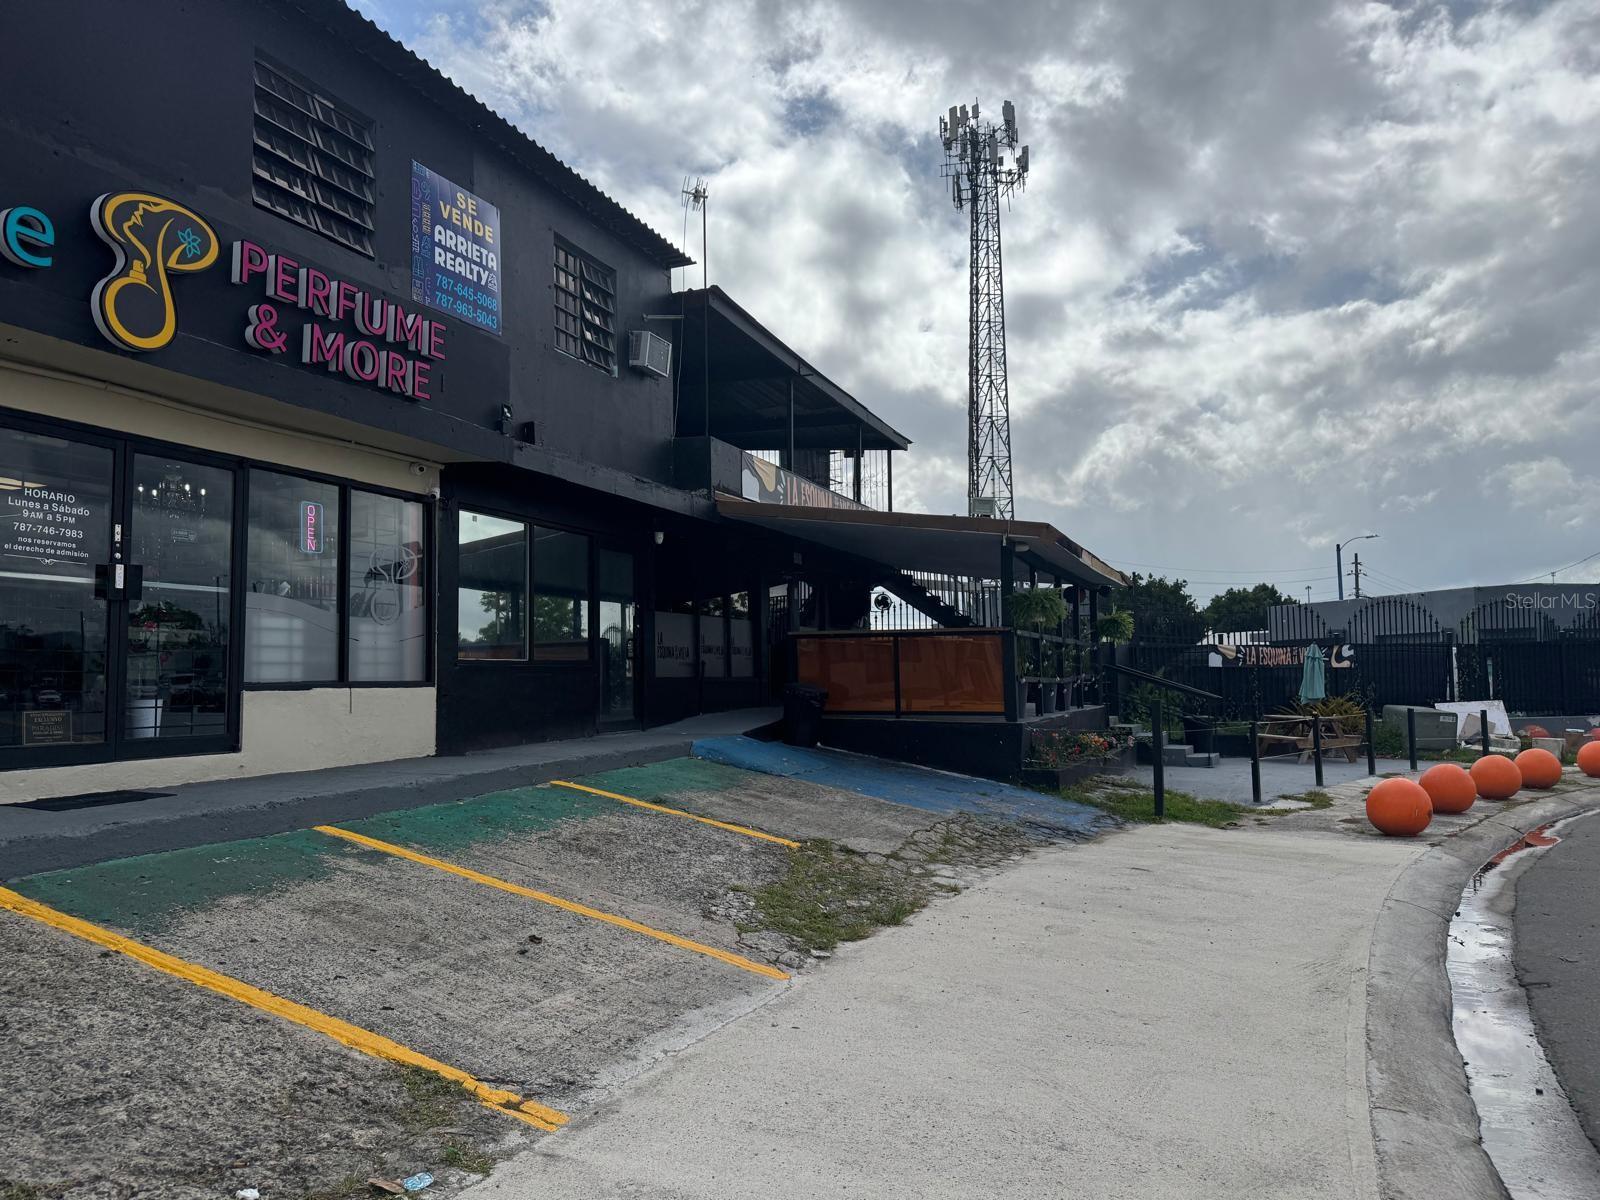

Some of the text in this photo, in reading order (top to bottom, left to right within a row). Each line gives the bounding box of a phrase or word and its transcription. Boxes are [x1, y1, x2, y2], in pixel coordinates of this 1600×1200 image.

[456, 192, 478, 216] SE
[439, 200, 494, 244] VENDE
[434, 224, 498, 271] ARRIETA
[434, 246, 489, 286] REALTY
[232, 240, 447, 361] PERFUME
[435, 273, 497, 311] 787-645-5068
[435, 291, 497, 329] 787-963-5043
[247, 304, 431, 400] & MORE
[8, 496, 40, 509] Lunes
[51, 503, 90, 516] Sábado
[24, 488, 75, 504] HORARIO
[13, 521, 83, 539] 787-746-7983
[46, 513, 53, 521] a
[307, 505, 316, 551] OPEN
[13, 543, 44, 553] derecho
[56, 548, 89, 558] admisión
[33, 538, 77, 549] reservamos
[1246, 646, 1257, 665] LA
[1259, 646, 1292, 667] ESQUINA
